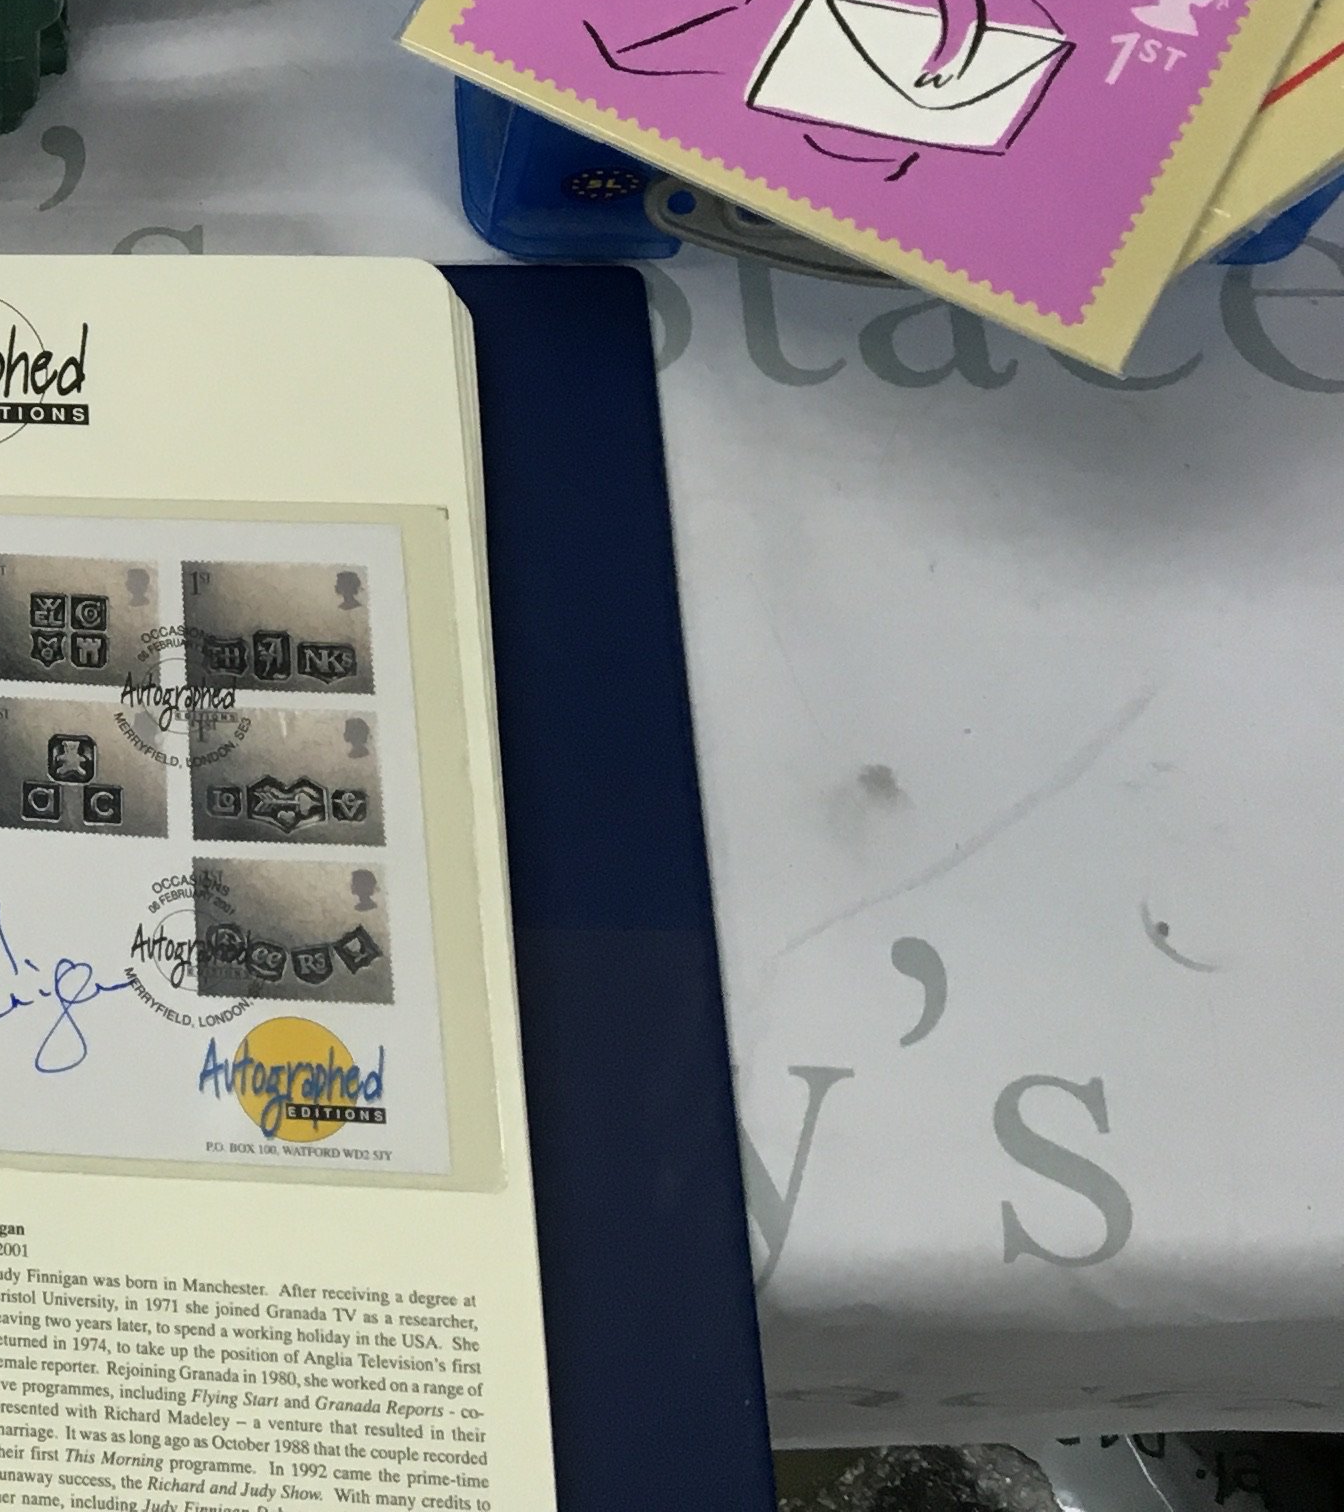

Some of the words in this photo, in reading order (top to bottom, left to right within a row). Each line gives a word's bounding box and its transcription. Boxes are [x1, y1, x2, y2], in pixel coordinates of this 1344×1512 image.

[1106, 30, 1188, 85] 1ST
[120, 671, 237, 732] Autographed
[198, 1036, 386, 1139] Autographed
[287, 1105, 386, 1122] EDITIONS
[229, 1142, 255, 1154] BOX
[282, 1146, 341, 1158] WATFORD
[342, 1148, 370, 1160] WD2
[26, 1267, 89, 1290] Finnigan
[92, 1275, 122, 1289] was
[124, 1273, 159, 1291] born
[163, 1276, 178, 1292] in
[182, 1277, 269, 1297] Manchester.
[278, 1282, 318, 1299] After
[321, 1286, 391, 1308] receiving
[394, 1292, 404, 1304] a
[408, 1289, 458, 1310] degree
[463, 1295, 477, 1309] at
[41, 1290, 119, 1313] University,
[124, 1295, 139, 1312] in
[144, 1296, 179, 1314] 1971
[184, 1299, 210, 1315] she
[214, 1300, 261, 1321] joined
[265, 1303, 328, 1322] Granada
[331, 1306, 357, 1323] TV
[362, 1312, 379, 1325] as
[384, 1314, 394, 1326] a
[398, 1313, 479, 1333] researcher,
